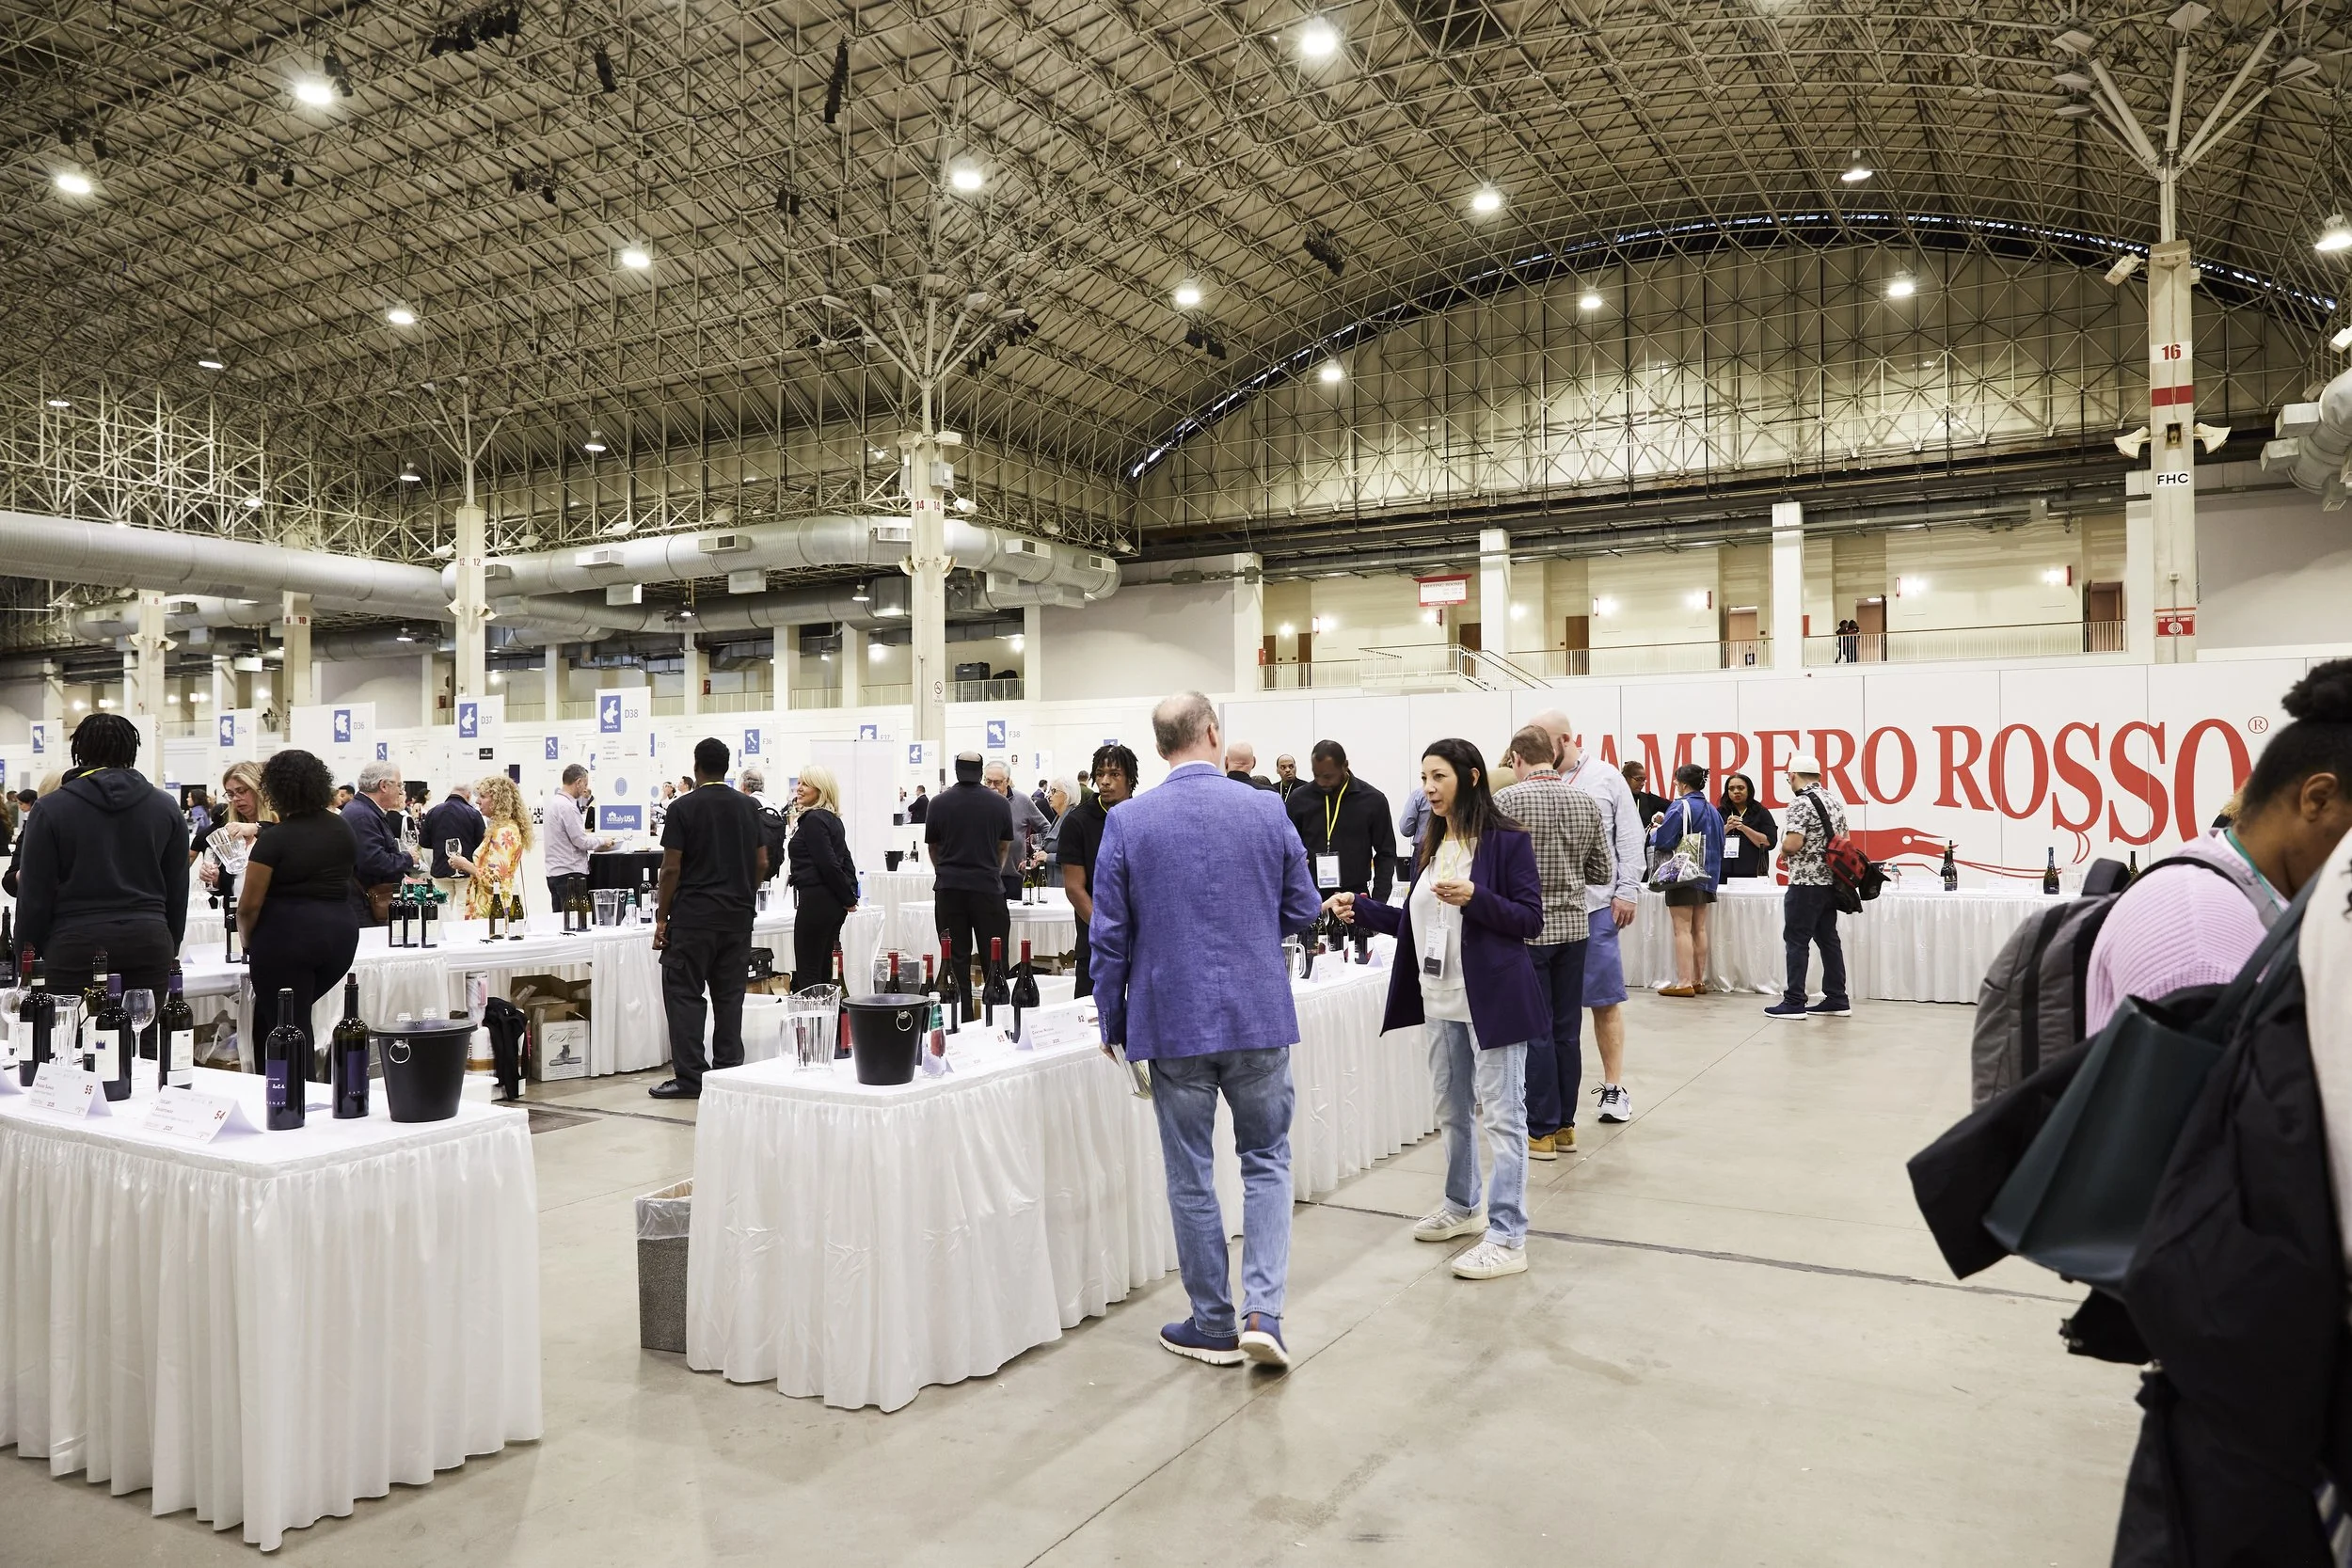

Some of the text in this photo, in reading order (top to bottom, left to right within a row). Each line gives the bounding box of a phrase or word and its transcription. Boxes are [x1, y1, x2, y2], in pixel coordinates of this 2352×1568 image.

[2161, 344, 2181, 360] 16
[2157, 473, 2188, 484] FHC
[915, 499, 924, 511] 14
[933, 500, 941, 511] 14
[459, 557, 466, 566] 12
[472, 558, 481, 567] 12
[298, 616, 307, 626] 10
[625, 709, 639, 719] D38
[353, 721, 365, 730] D36
[481, 716, 493, 725] D37
[1077, 1015, 1085, 1023] 82
[996, 1034, 1006, 1043] 83
[84, 1085, 93, 1095] 55
[214, 1110, 227, 1121] 54
